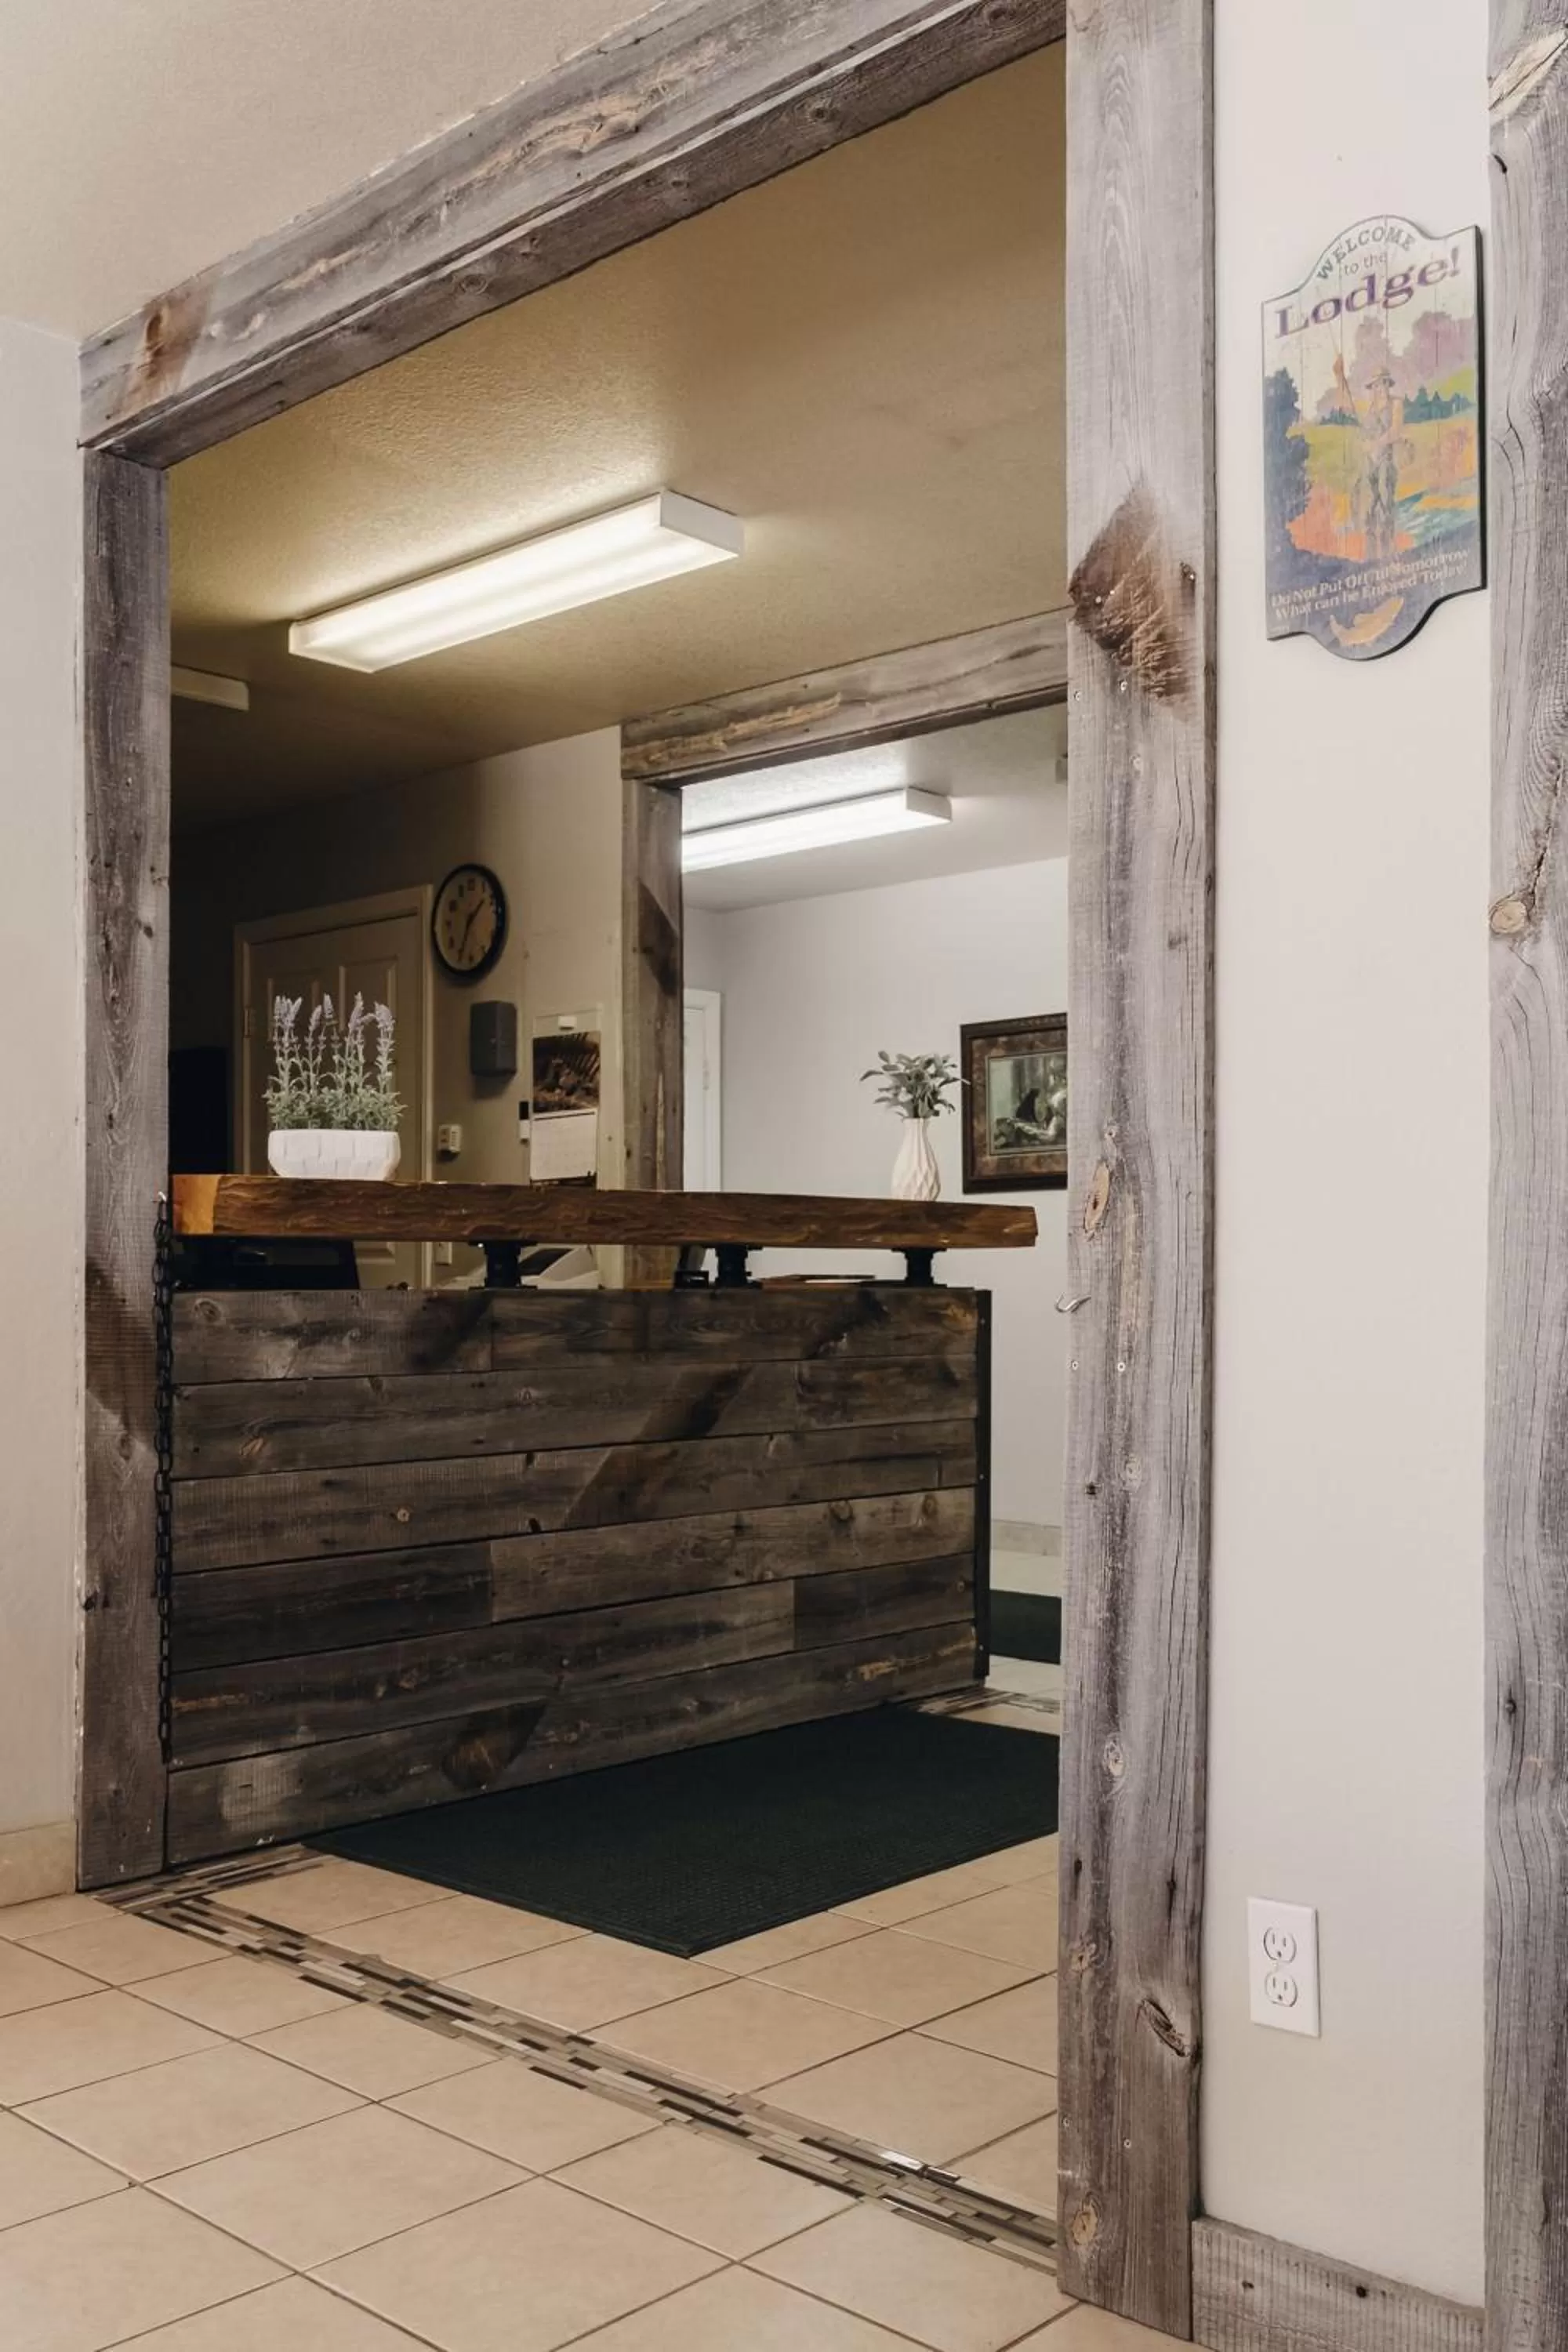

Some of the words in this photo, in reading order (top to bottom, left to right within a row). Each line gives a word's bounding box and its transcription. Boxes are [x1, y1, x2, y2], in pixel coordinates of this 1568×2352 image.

[1316, 226, 1416, 280] WELCOME
[1344, 263, 1359, 276] to
[1363, 252, 1387, 268] the
[1275, 246, 1460, 339] Lodge!
[1319, 579, 1341, 596] Put
[1315, 596, 1339, 610] can
